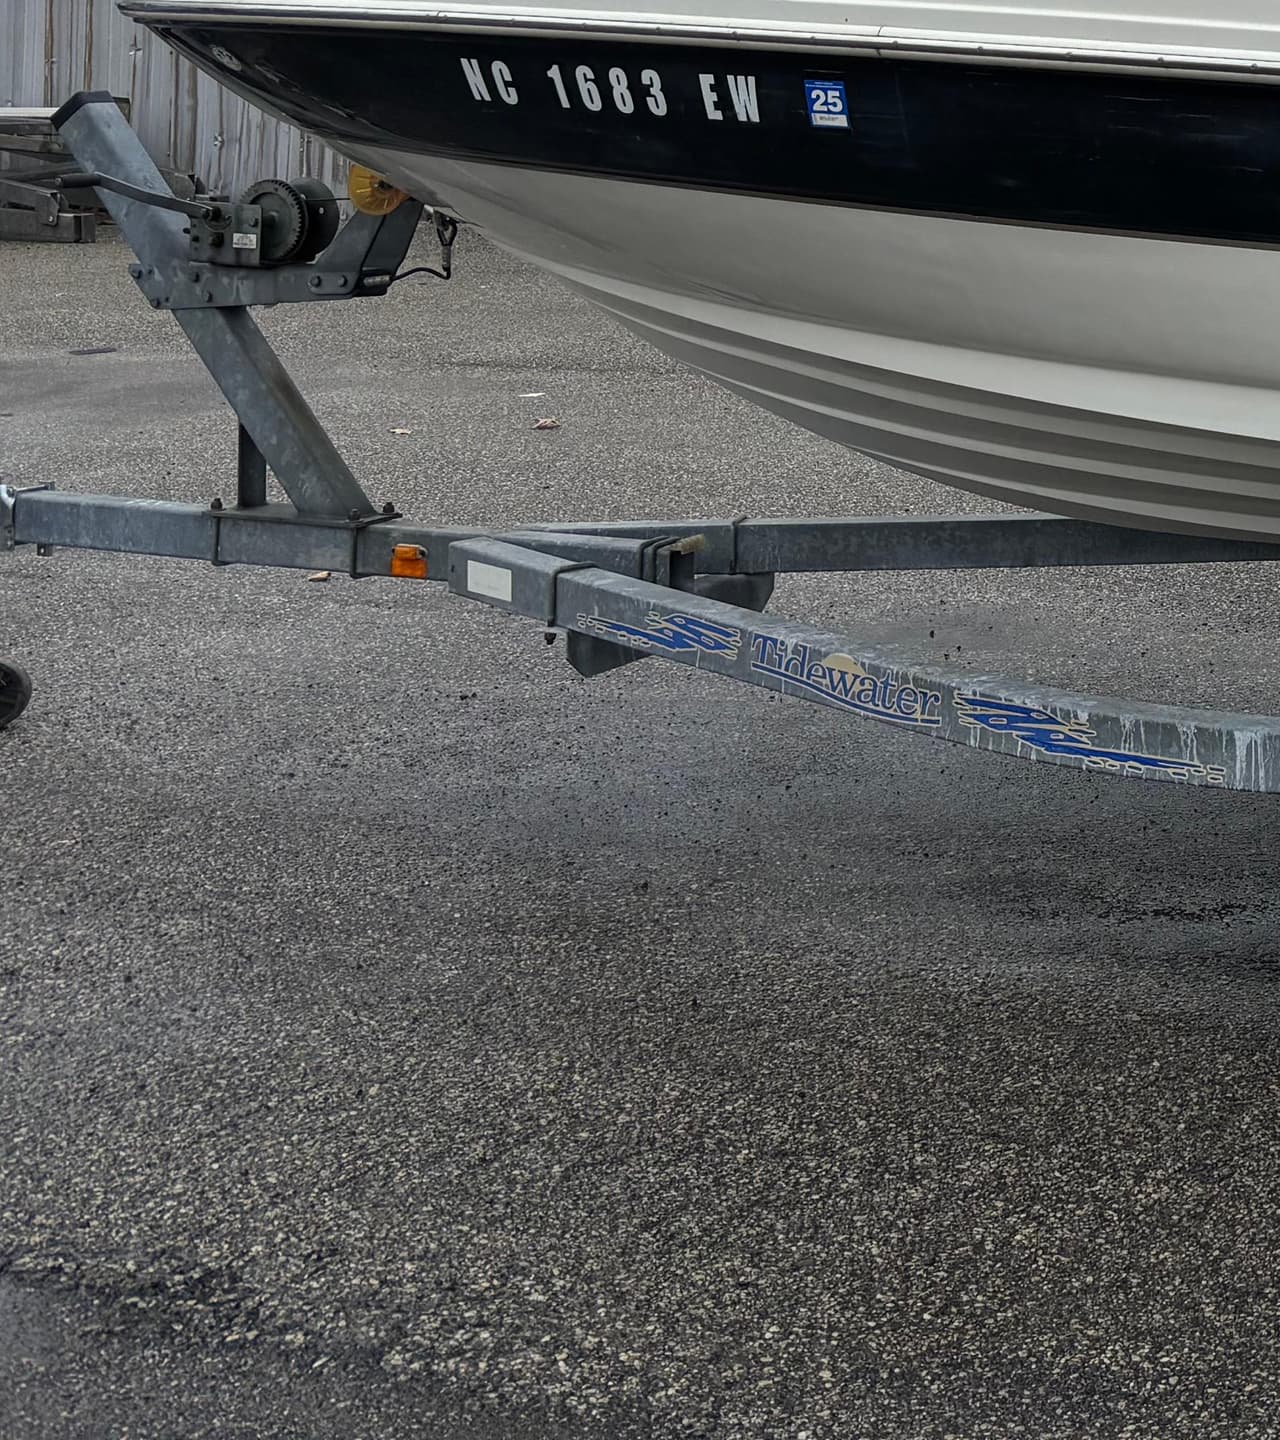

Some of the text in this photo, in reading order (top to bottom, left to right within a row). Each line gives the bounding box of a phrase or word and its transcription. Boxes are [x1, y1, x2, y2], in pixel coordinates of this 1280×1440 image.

[460, 58, 760, 122] NC 1683 EW
[811, 89, 843, 113] 25
[752, 633, 941, 717] Tidewater
